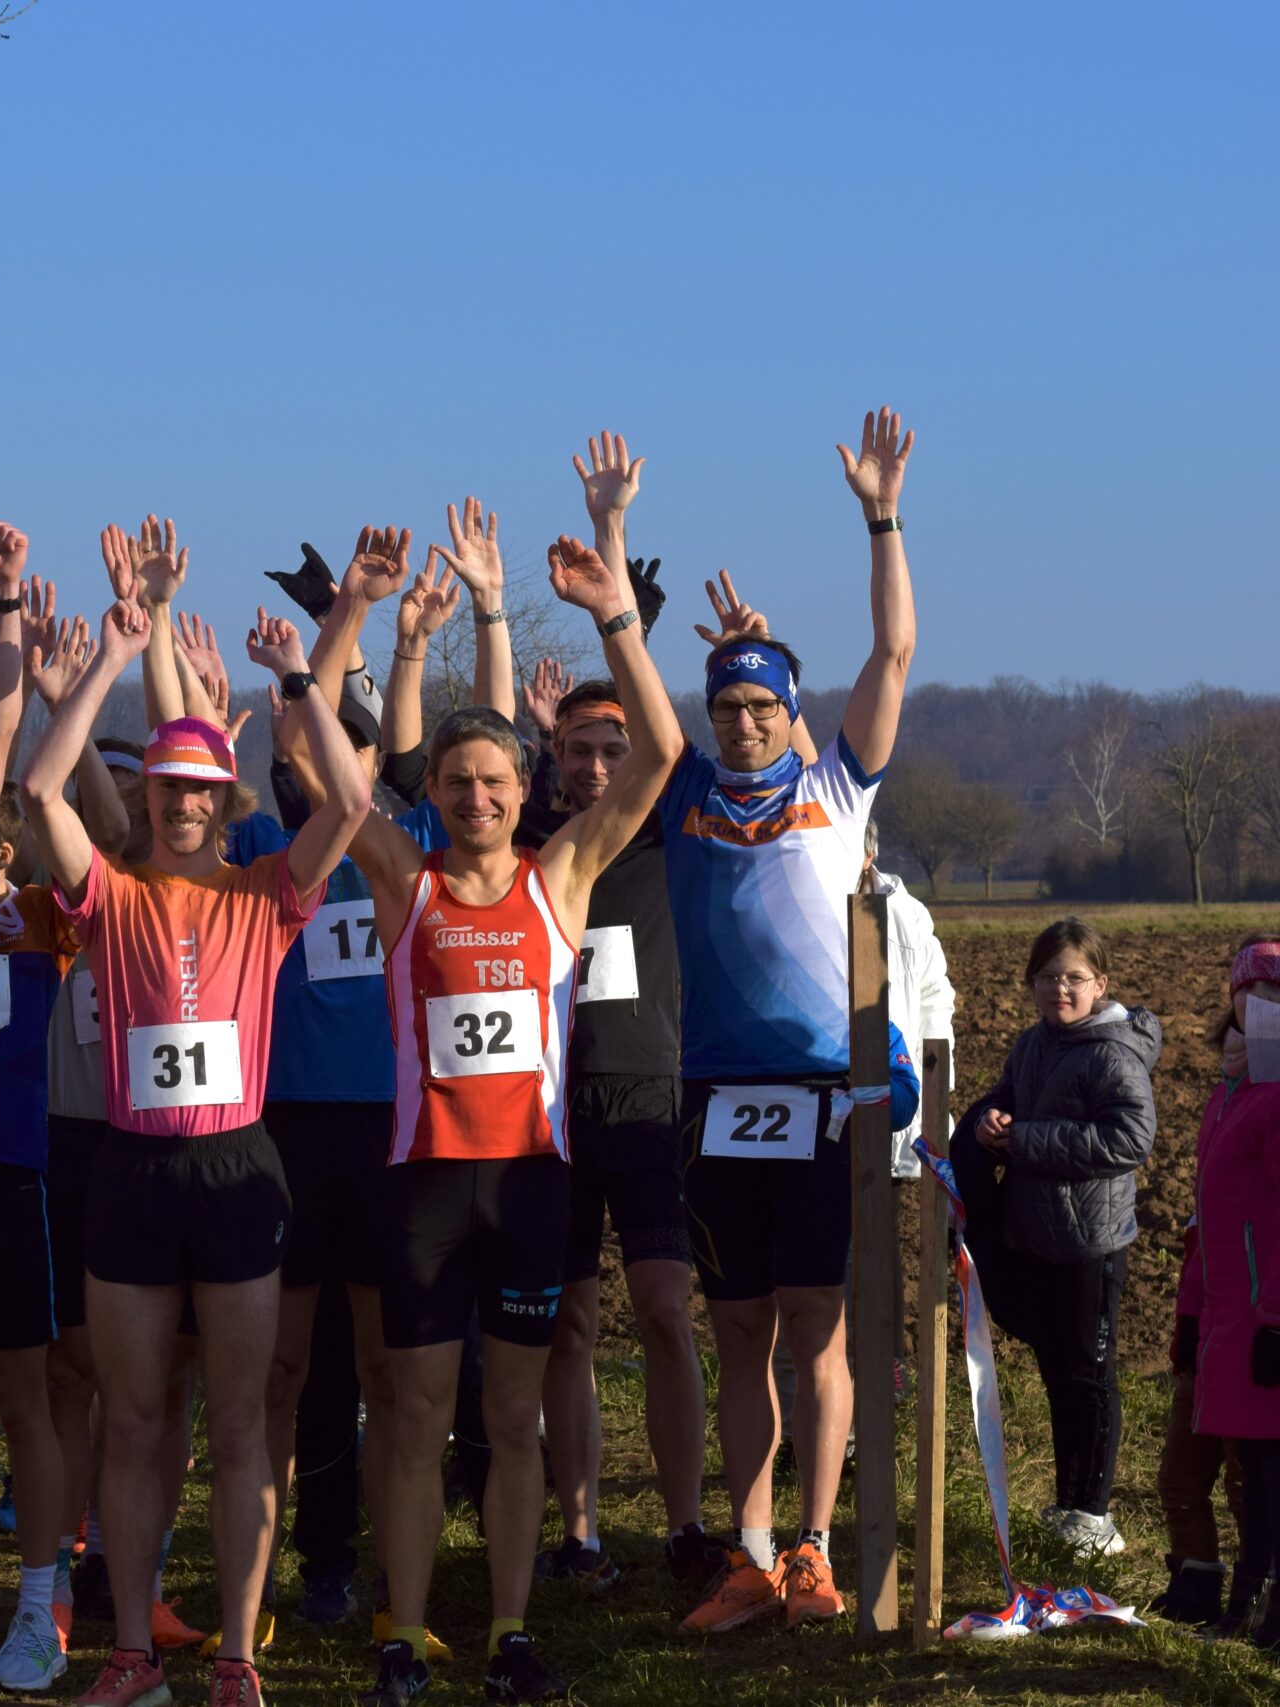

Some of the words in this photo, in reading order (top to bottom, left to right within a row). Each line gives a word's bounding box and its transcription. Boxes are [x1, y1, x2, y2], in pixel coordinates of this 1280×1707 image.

[329, 917, 379, 960] 17
[434, 925, 526, 949] Teusser
[178, 928, 199, 1023] RRELL
[473, 959, 524, 987] TSG
[453, 1010, 516, 1058] 32
[152, 1041, 207, 1089] 31
[729, 1103, 791, 1142] 22
